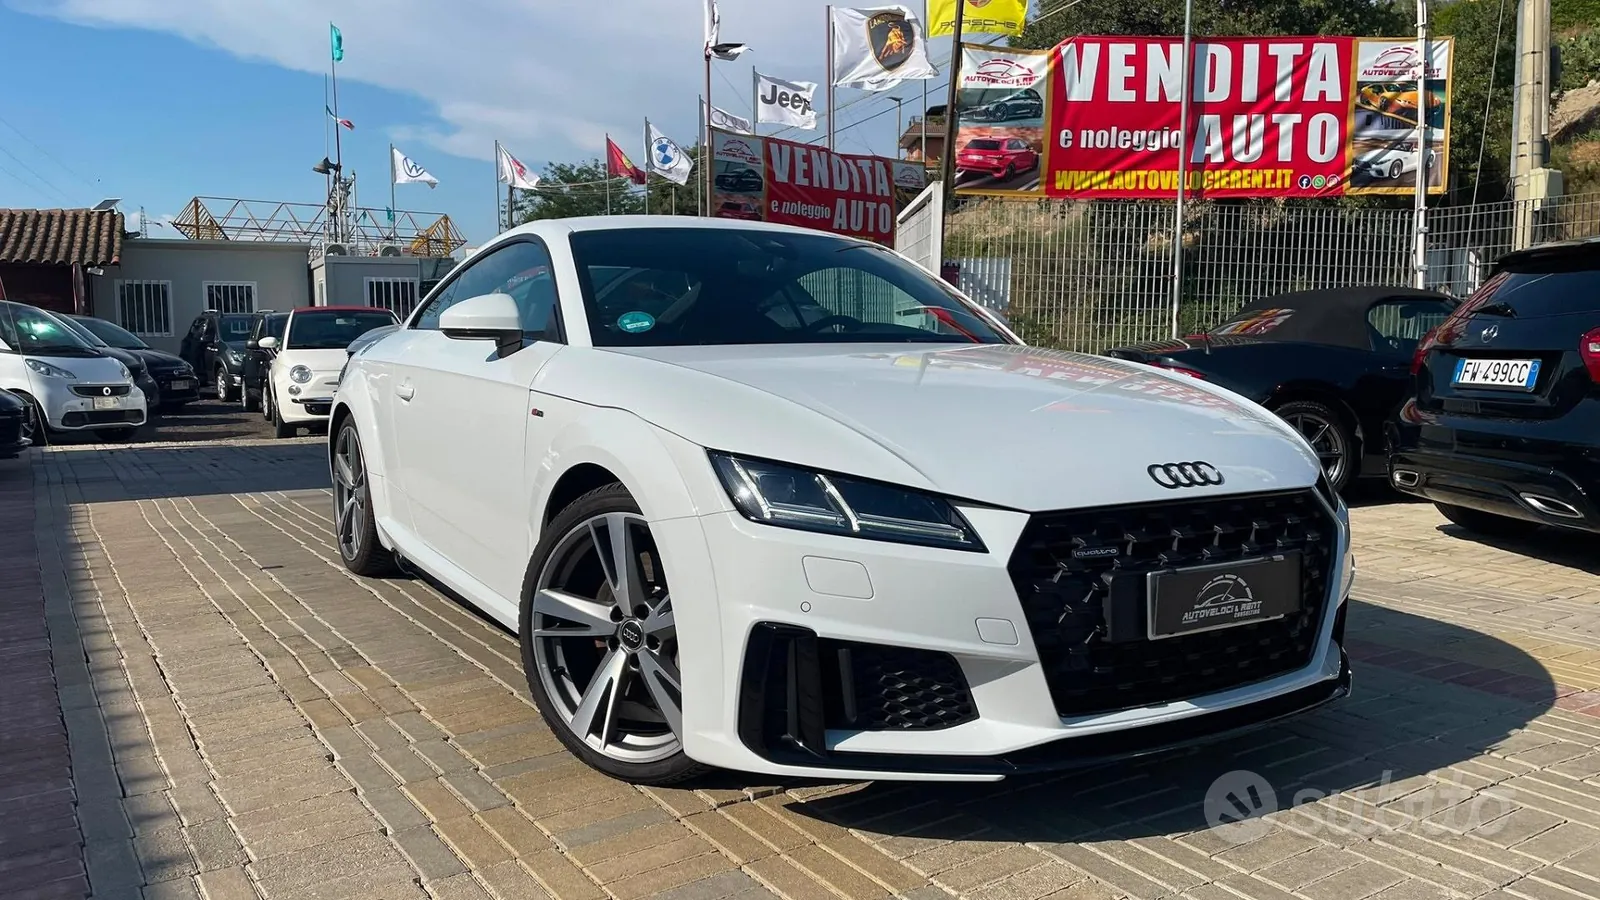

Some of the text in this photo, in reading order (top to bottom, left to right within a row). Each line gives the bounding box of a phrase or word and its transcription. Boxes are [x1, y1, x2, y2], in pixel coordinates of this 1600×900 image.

[1061, 43, 1342, 102] VENDITA
[760, 84, 811, 115] Jeep
[1060, 126, 1182, 151] e noleggio
[1191, 112, 1339, 163] AUTO
[769, 142, 890, 197] VENDITA
[1055, 168, 1294, 190] WWW.AUTOVELOCIERENT.IT
[771, 200, 831, 219] e noleggio
[833, 198, 892, 234] AUTO
[1077, 549, 1117, 557] quattro
[1182, 604, 1234, 621] AUTOVELOCI
[1241, 601, 1262, 611] RENT
